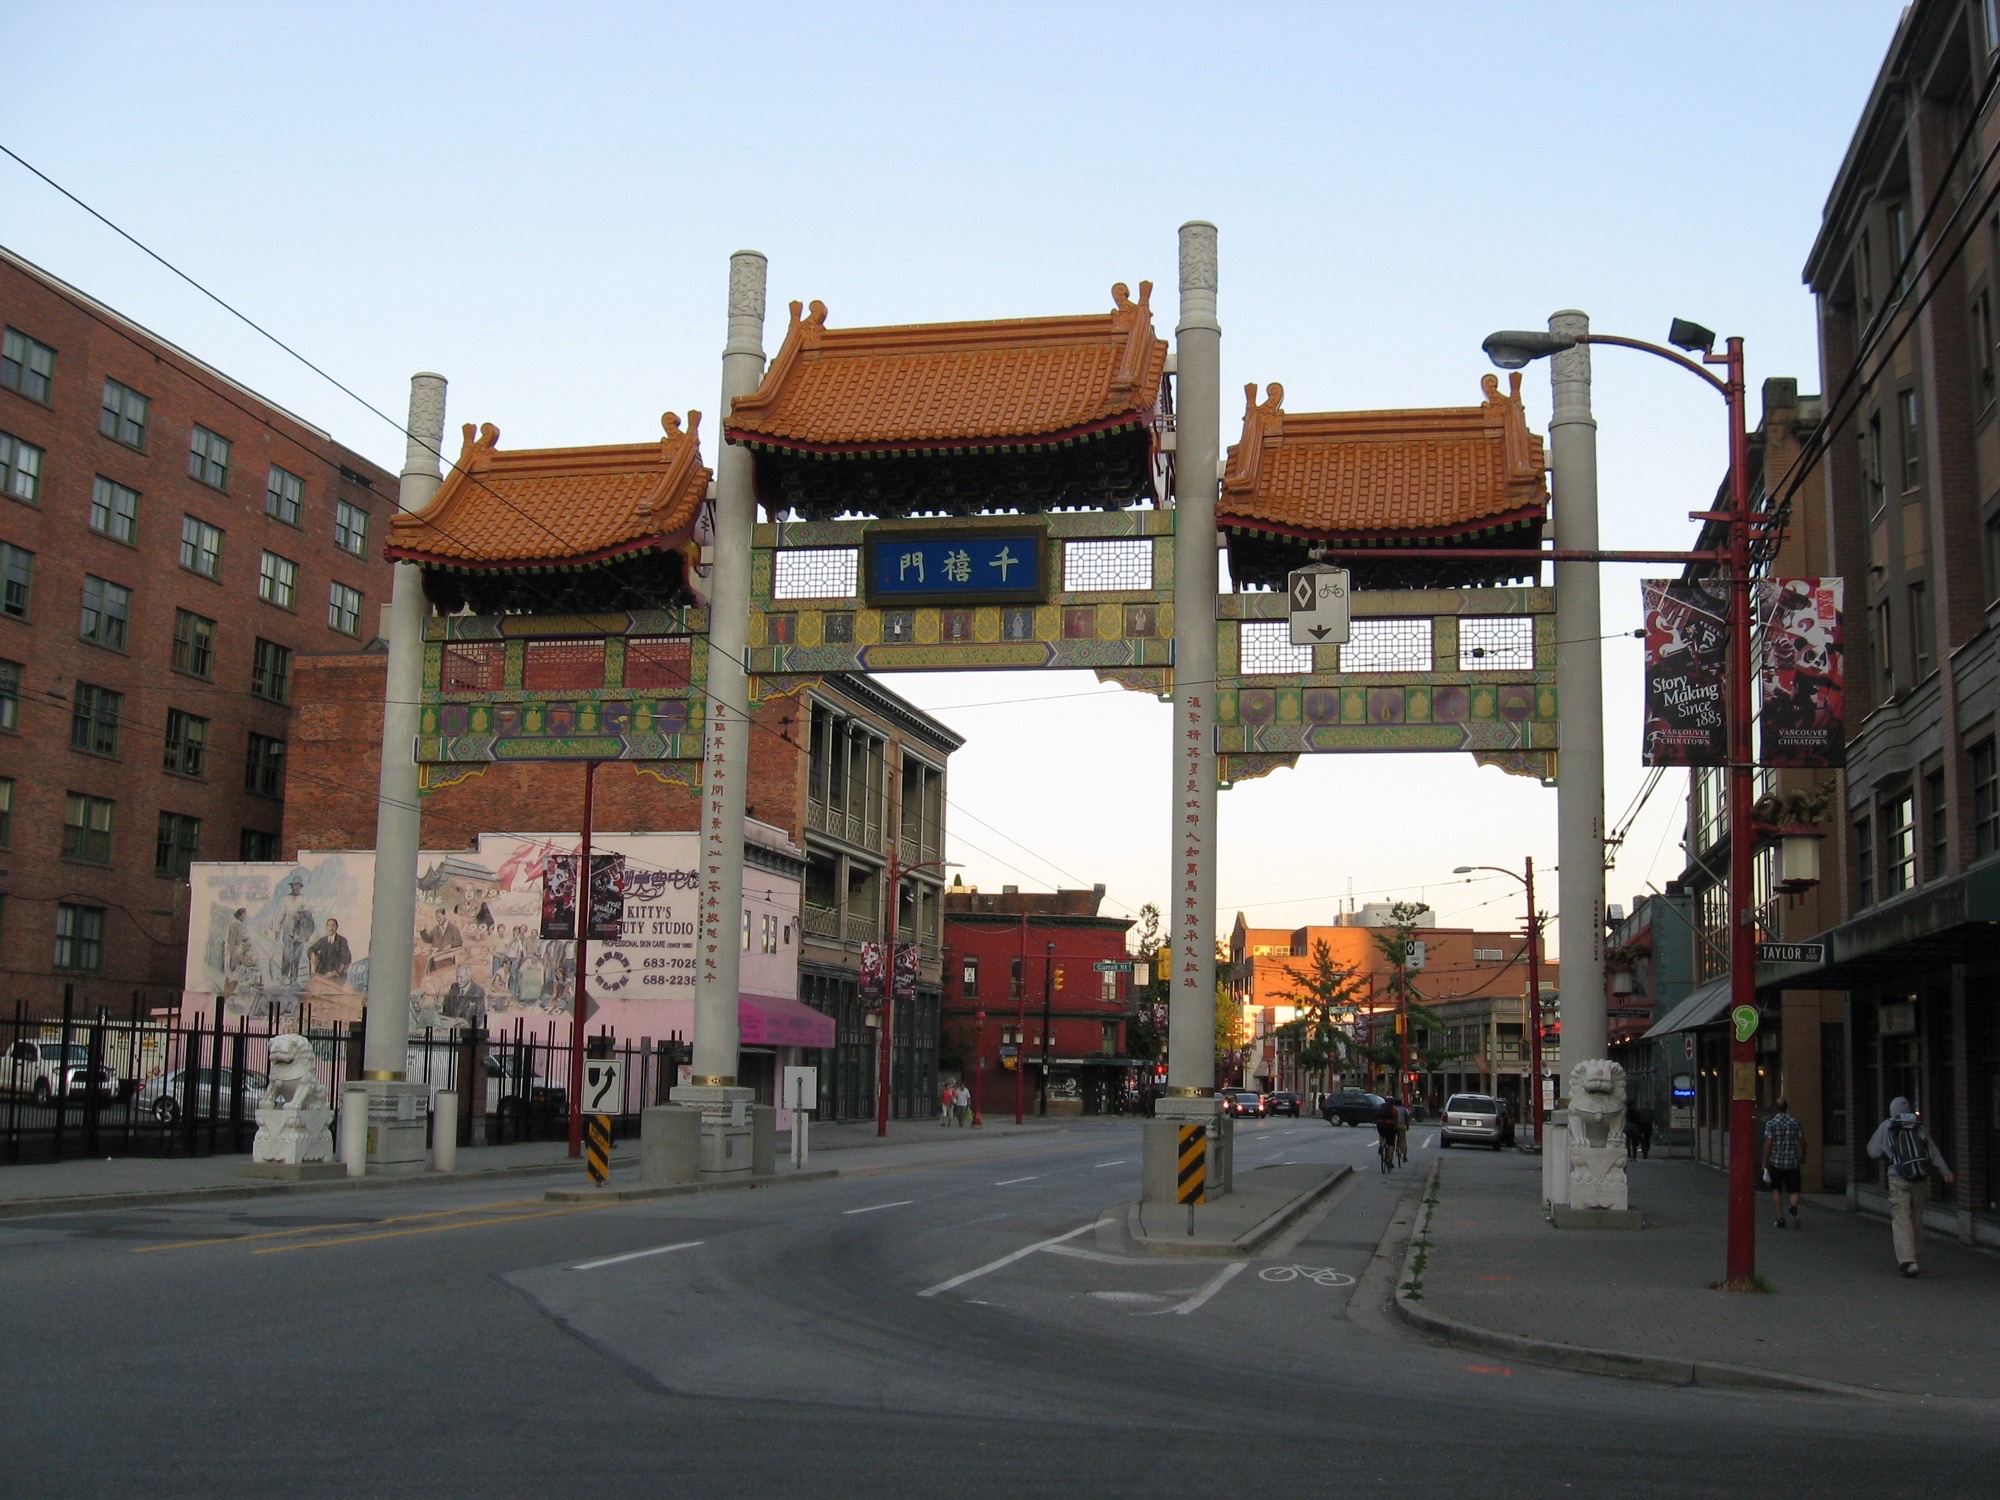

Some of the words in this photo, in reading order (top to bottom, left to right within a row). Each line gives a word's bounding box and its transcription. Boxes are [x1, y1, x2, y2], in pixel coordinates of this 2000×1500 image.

[898, 545, 1020, 584] 千禧門
[1652, 675, 1687, 694] Story
[1663, 683, 1719, 707] Making
[1677, 701, 1712, 718] Since
[1696, 710, 1722, 727] 1885
[1661, 728, 1710, 737] VANCOUVER
[1661, 737, 1711, 745] CHINATOWN
[627, 906, 672, 918] KITTY'S
[622, 921, 645, 934] UTY
[652, 921, 694, 934] STUDIO
[652, 940, 666, 948] CARE
[1763, 946, 1801, 959] TAYLOR
